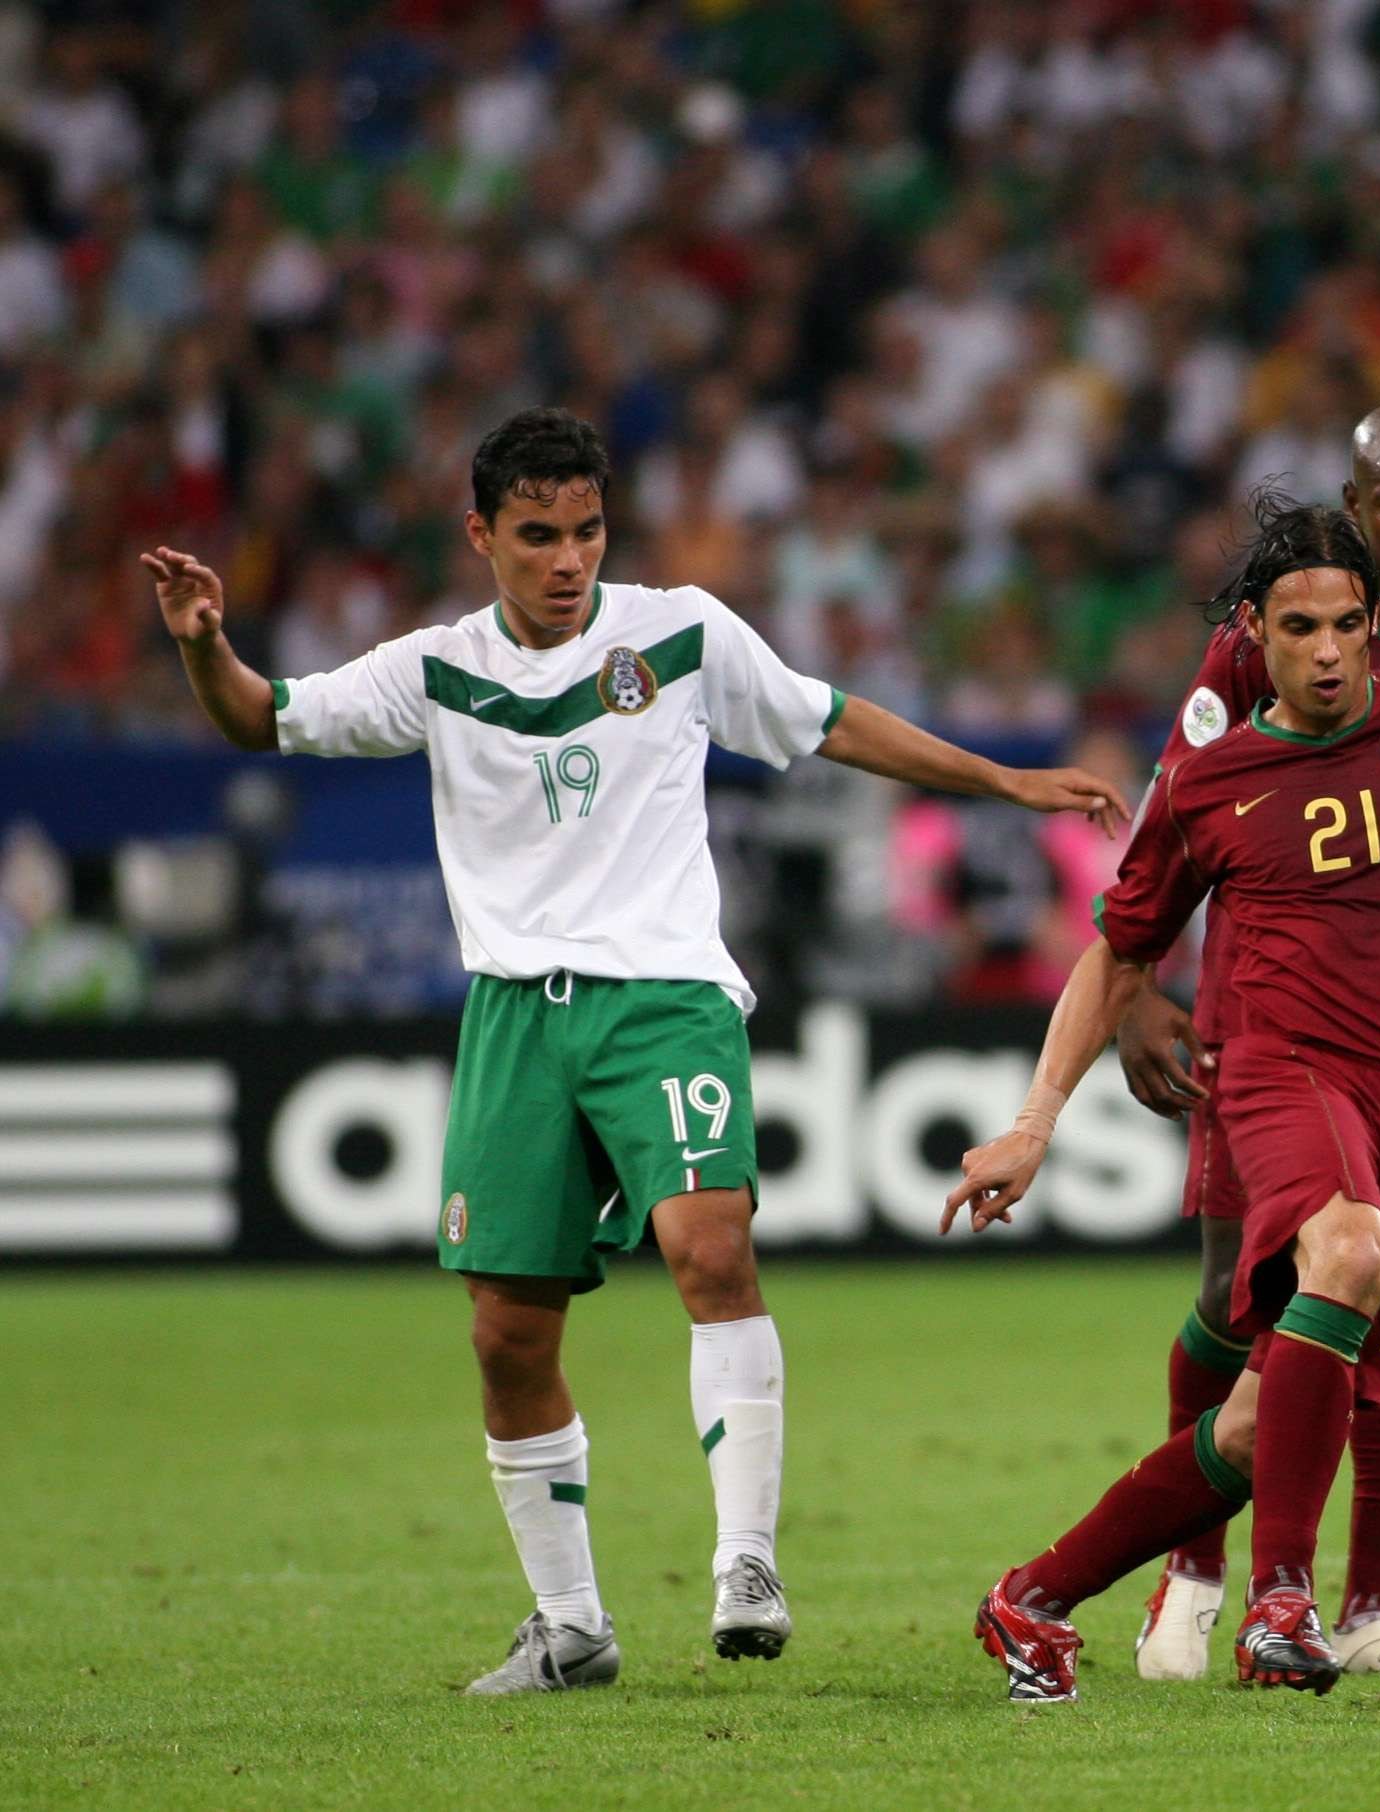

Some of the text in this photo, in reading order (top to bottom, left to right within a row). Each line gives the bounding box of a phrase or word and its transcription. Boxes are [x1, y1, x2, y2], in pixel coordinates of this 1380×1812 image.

[533, 743, 600, 824] 19
[268, 996, 1190, 1252] adas
[660, 1072, 732, 1144] 19
